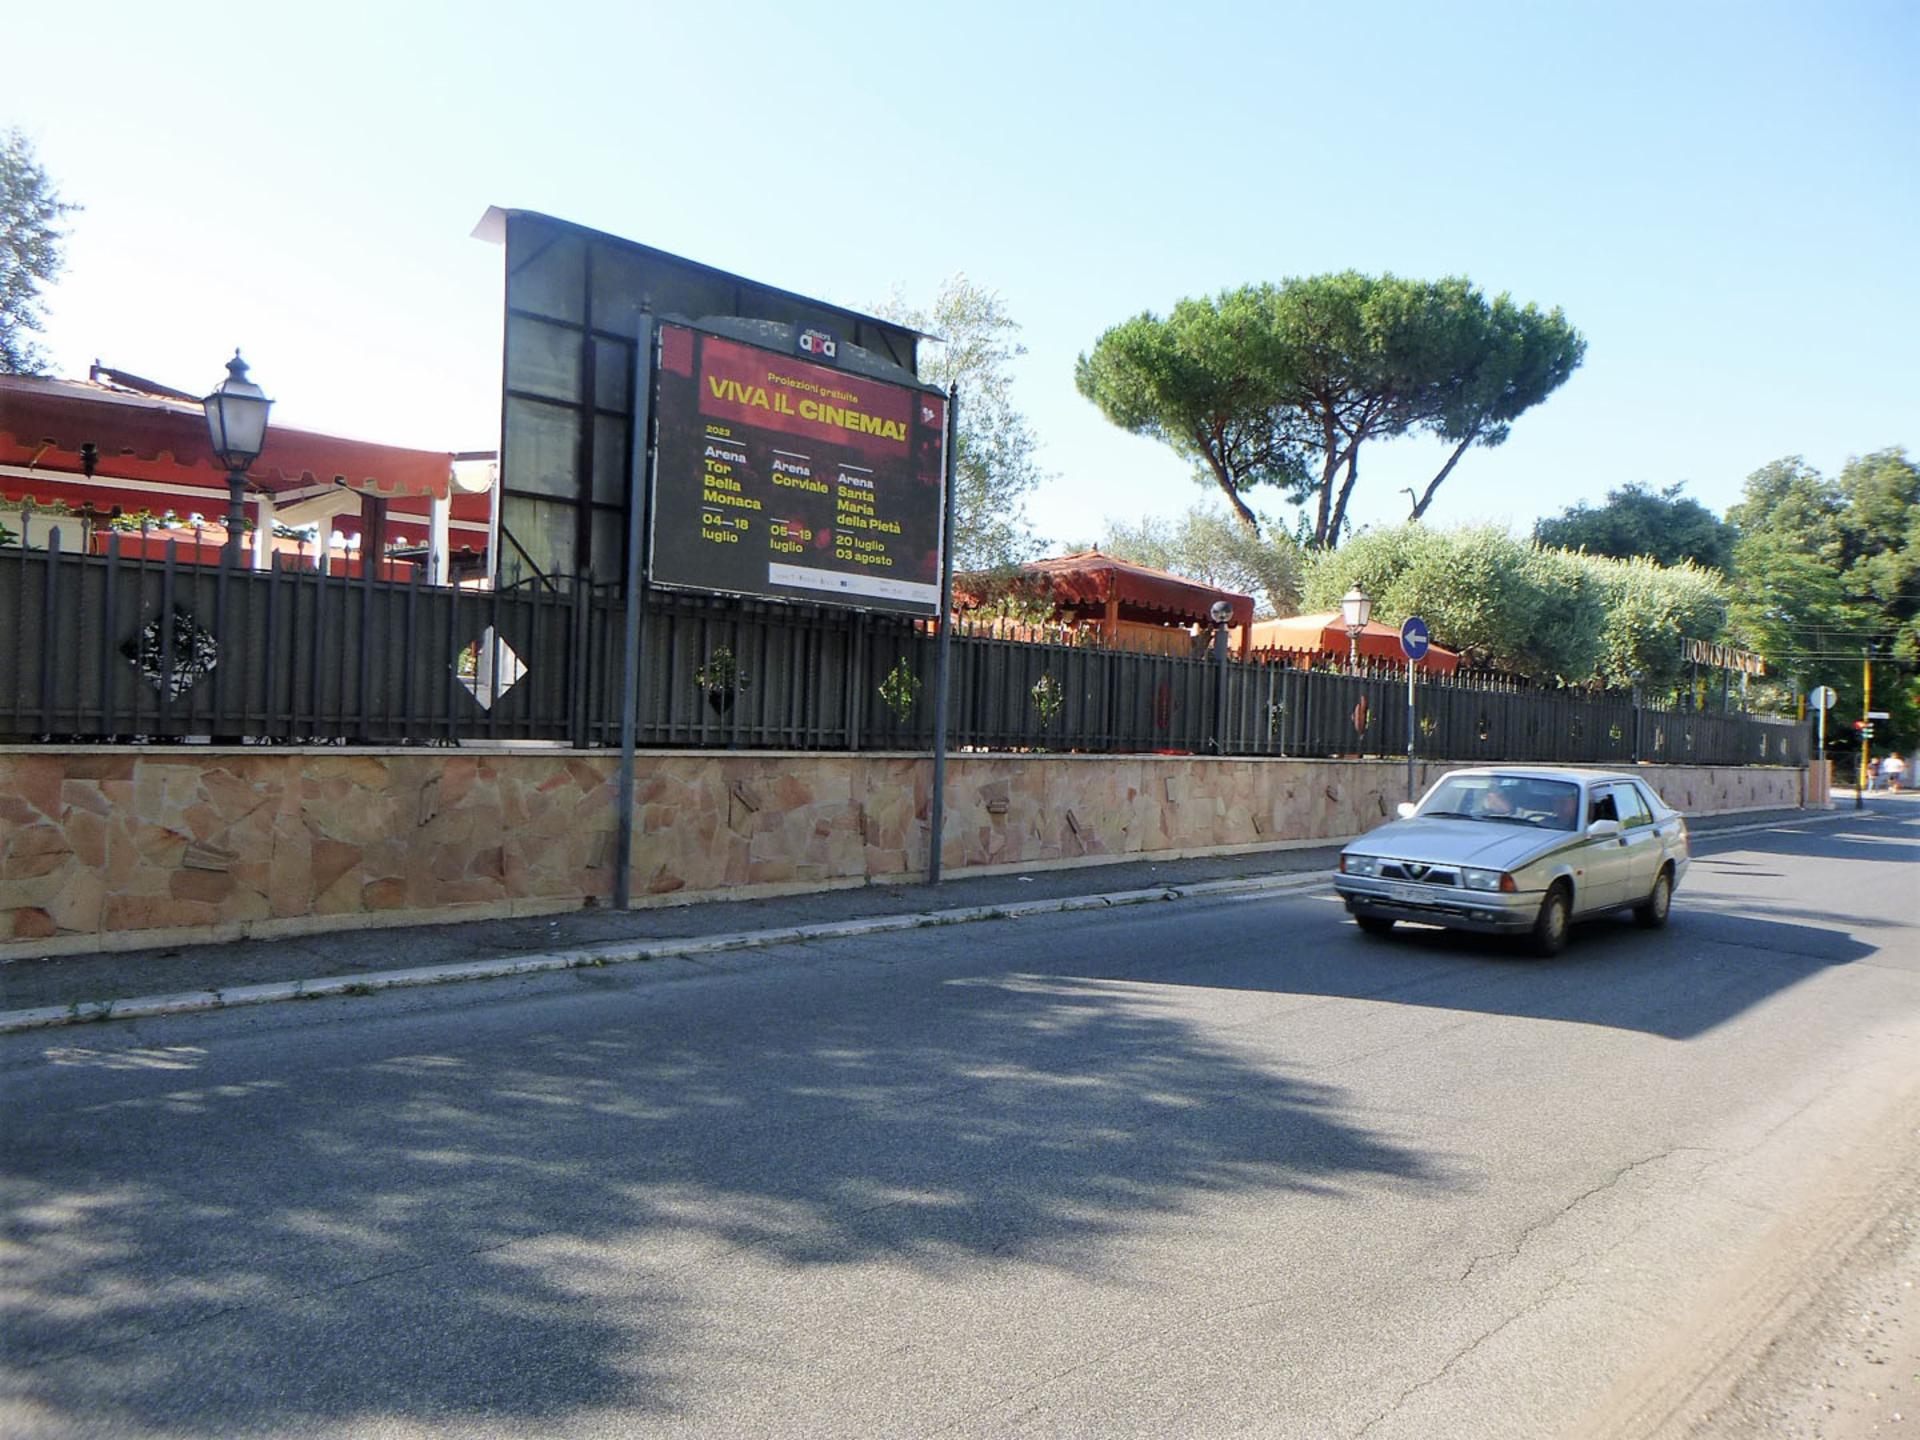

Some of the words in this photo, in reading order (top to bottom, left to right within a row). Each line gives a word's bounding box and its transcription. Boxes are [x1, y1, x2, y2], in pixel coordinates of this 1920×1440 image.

[799, 334, 836, 358] apa
[819, 387, 859, 404] gratuite
[708, 375, 770, 410] VIVA
[774, 393, 796, 416] IL
[799, 399, 907, 442] CINEMA!
[704, 445, 747, 464] Arena
[704, 459, 732, 475] Tor
[772, 459, 811, 477] Arena
[703, 474, 742, 493] Bella
[771, 473, 829, 495] Corviale
[837, 472, 875, 489] Arena
[703, 490, 762, 511] Monaca
[837, 485, 875, 503] Santa
[836, 499, 875, 517] Maria
[836, 513, 868, 530] della
[869, 518, 902, 535] Pietà
[702, 527, 739, 544] luglio
[835, 534, 853, 548] 20
[854, 538, 885, 553] luglio
[769, 538, 804, 554] luglio
[835, 548, 853, 561] 03
[854, 551, 893, 567] agosto
